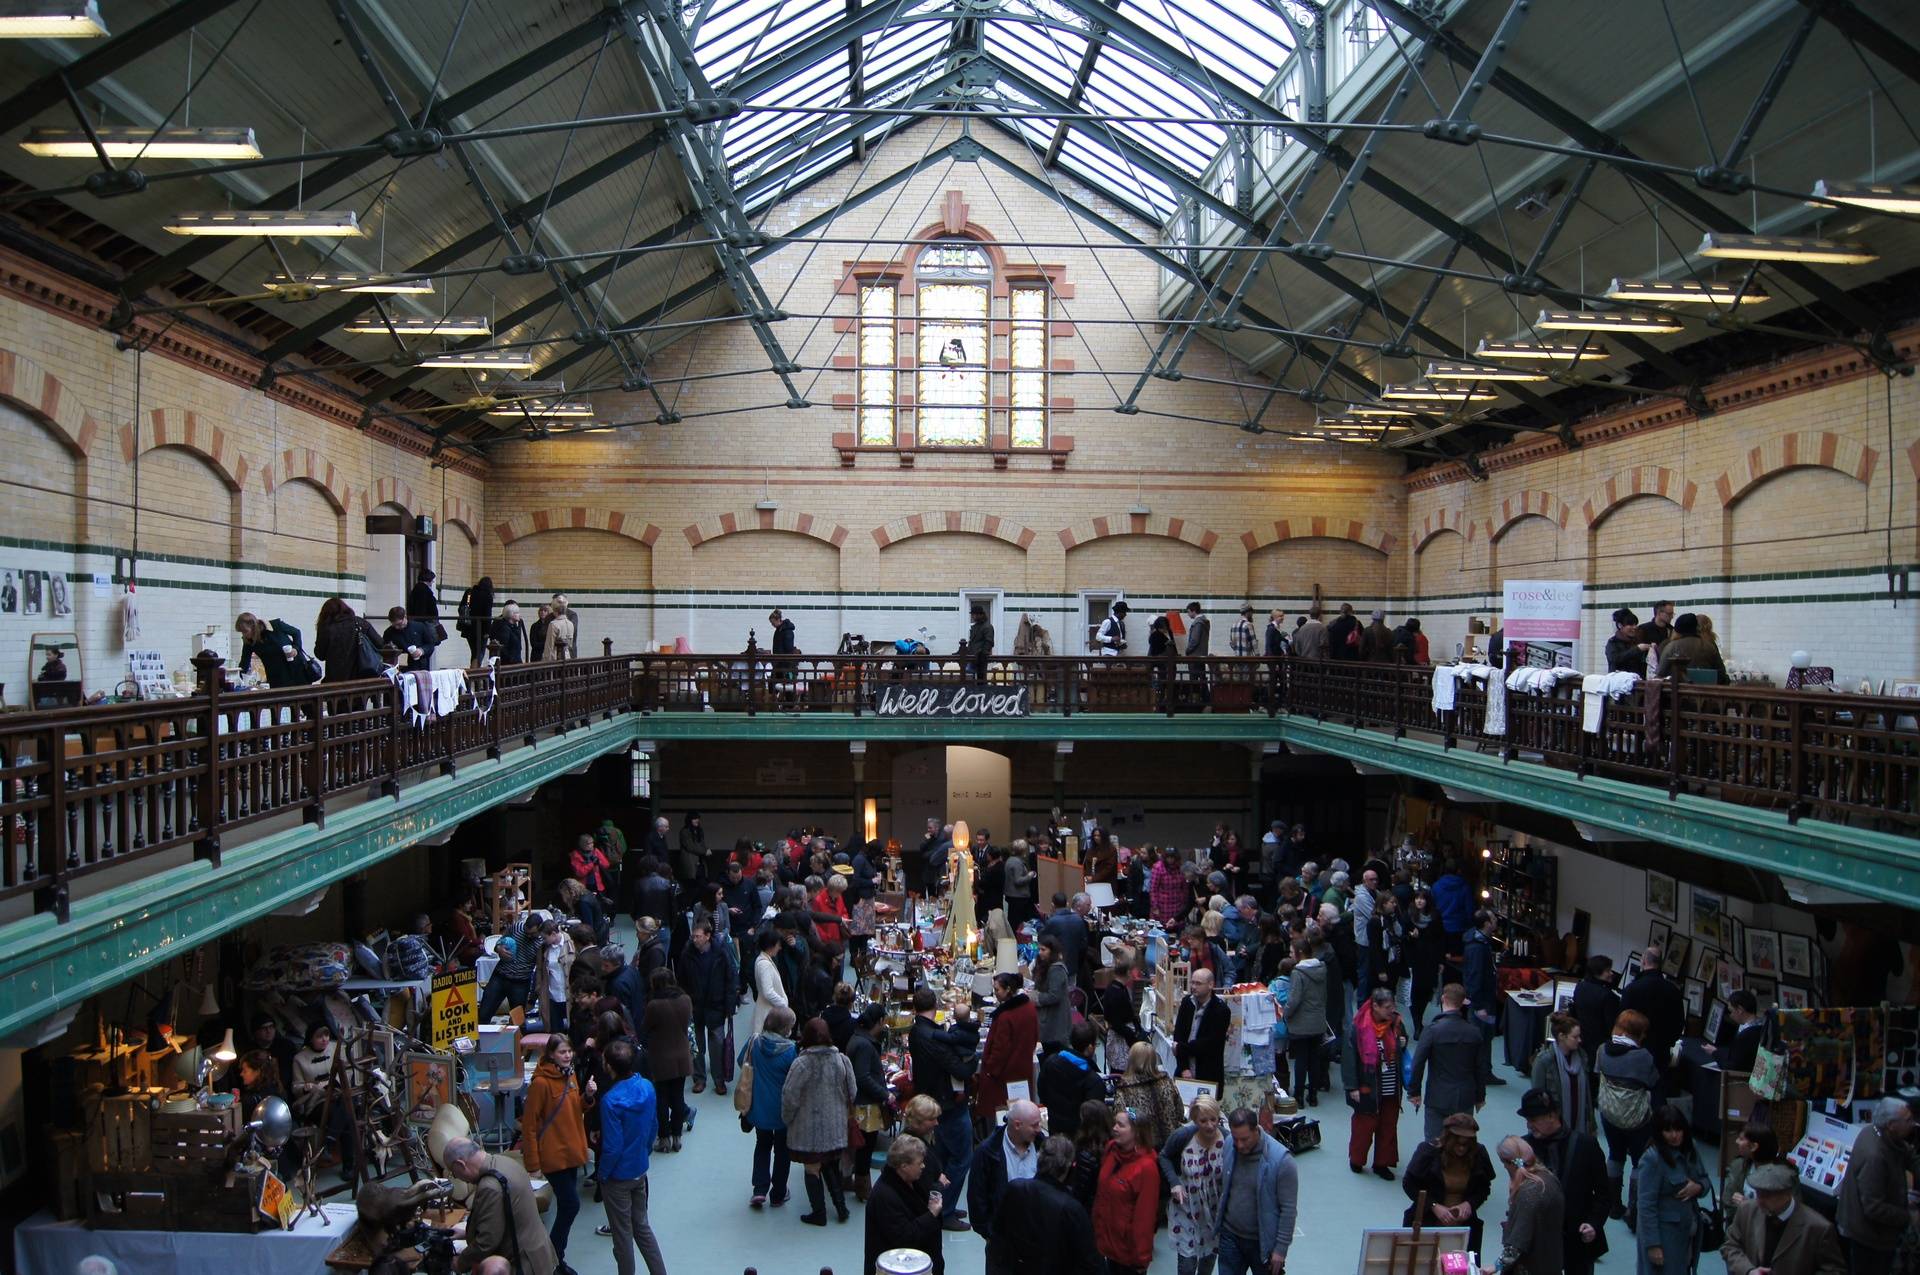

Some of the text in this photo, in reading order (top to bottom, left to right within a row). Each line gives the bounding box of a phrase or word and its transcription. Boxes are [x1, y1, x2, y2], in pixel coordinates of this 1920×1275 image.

[1512, 588, 1573, 601] rose&lee
[879, 687, 1026, 716] Well loved
[433, 970, 476, 988] RADIO TIMES
[440, 1003, 470, 1021] LOOK
[448, 1017, 462, 1026] AND
[436, 1021, 475, 1042] LISTEN
